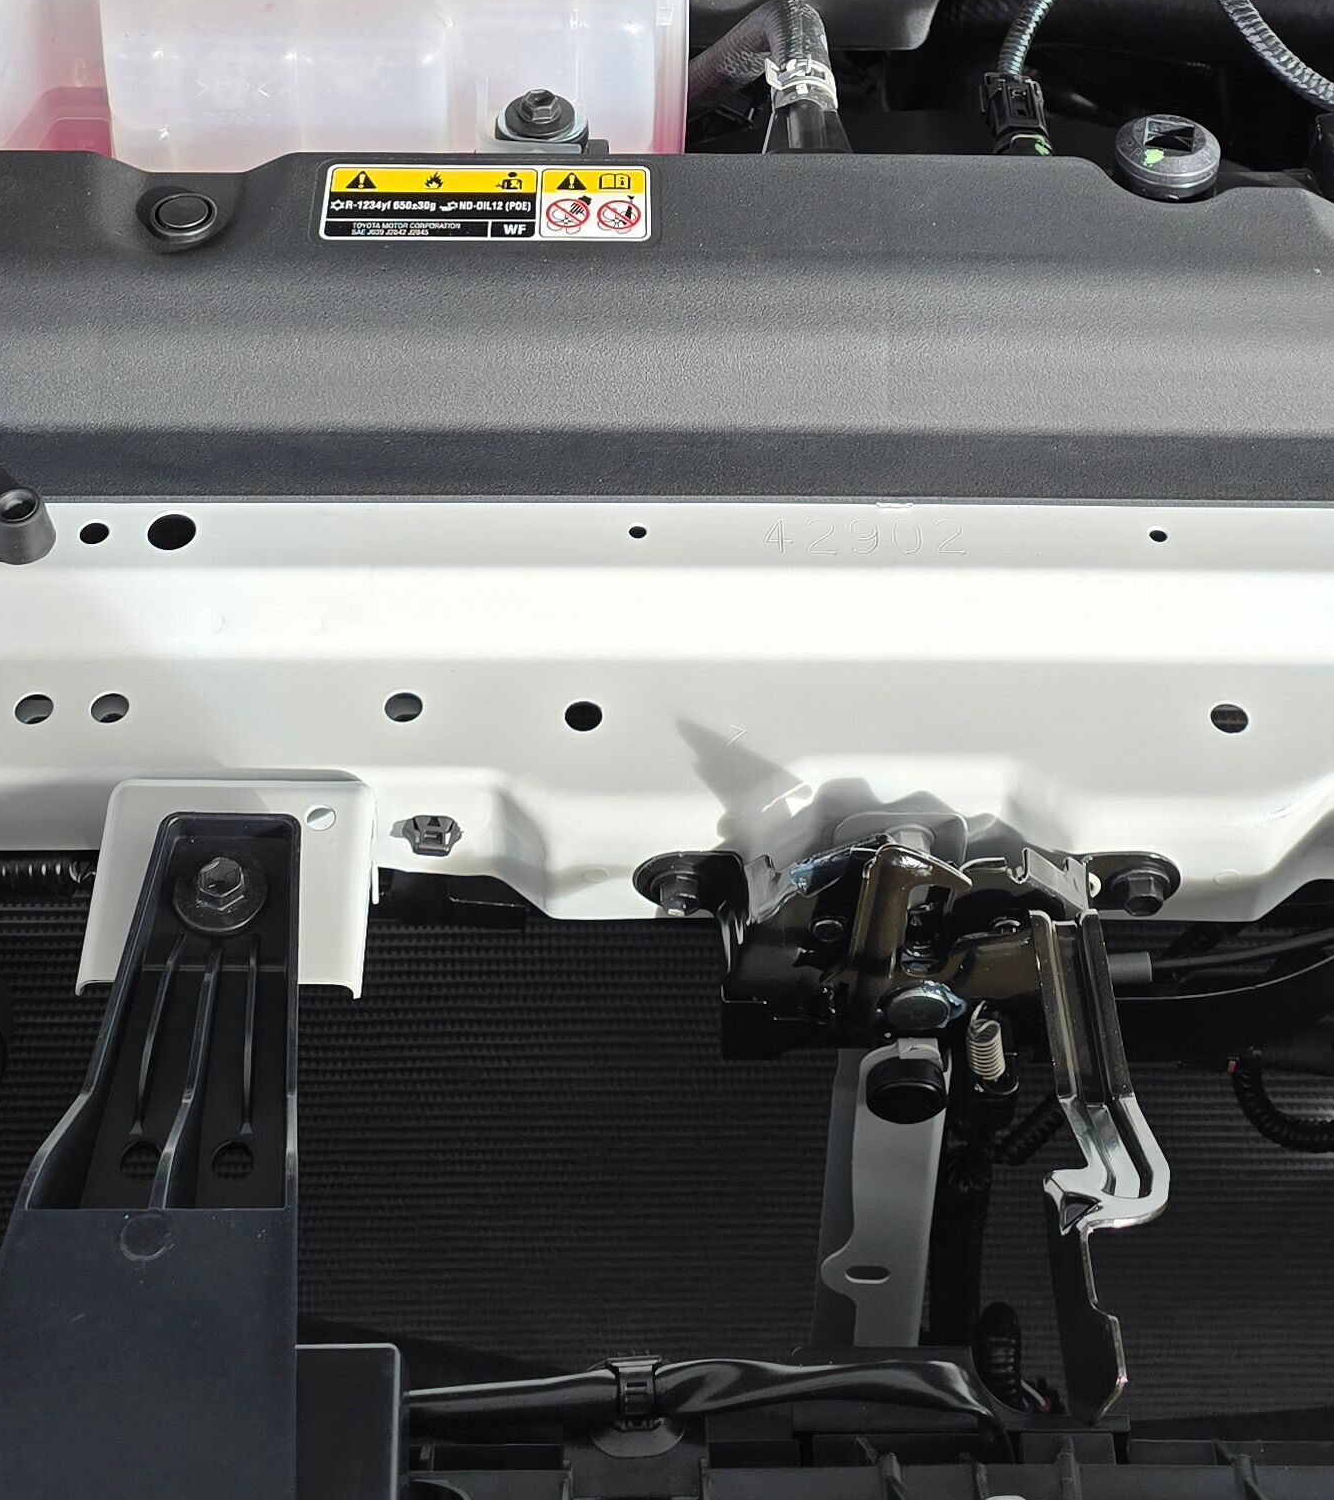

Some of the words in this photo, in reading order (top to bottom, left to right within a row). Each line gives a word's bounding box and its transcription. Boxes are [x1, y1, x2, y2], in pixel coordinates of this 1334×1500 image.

[505, 201, 532, 212] (POE)
[503, 223, 527, 235] WF
[762, 518, 967, 555] 42902
